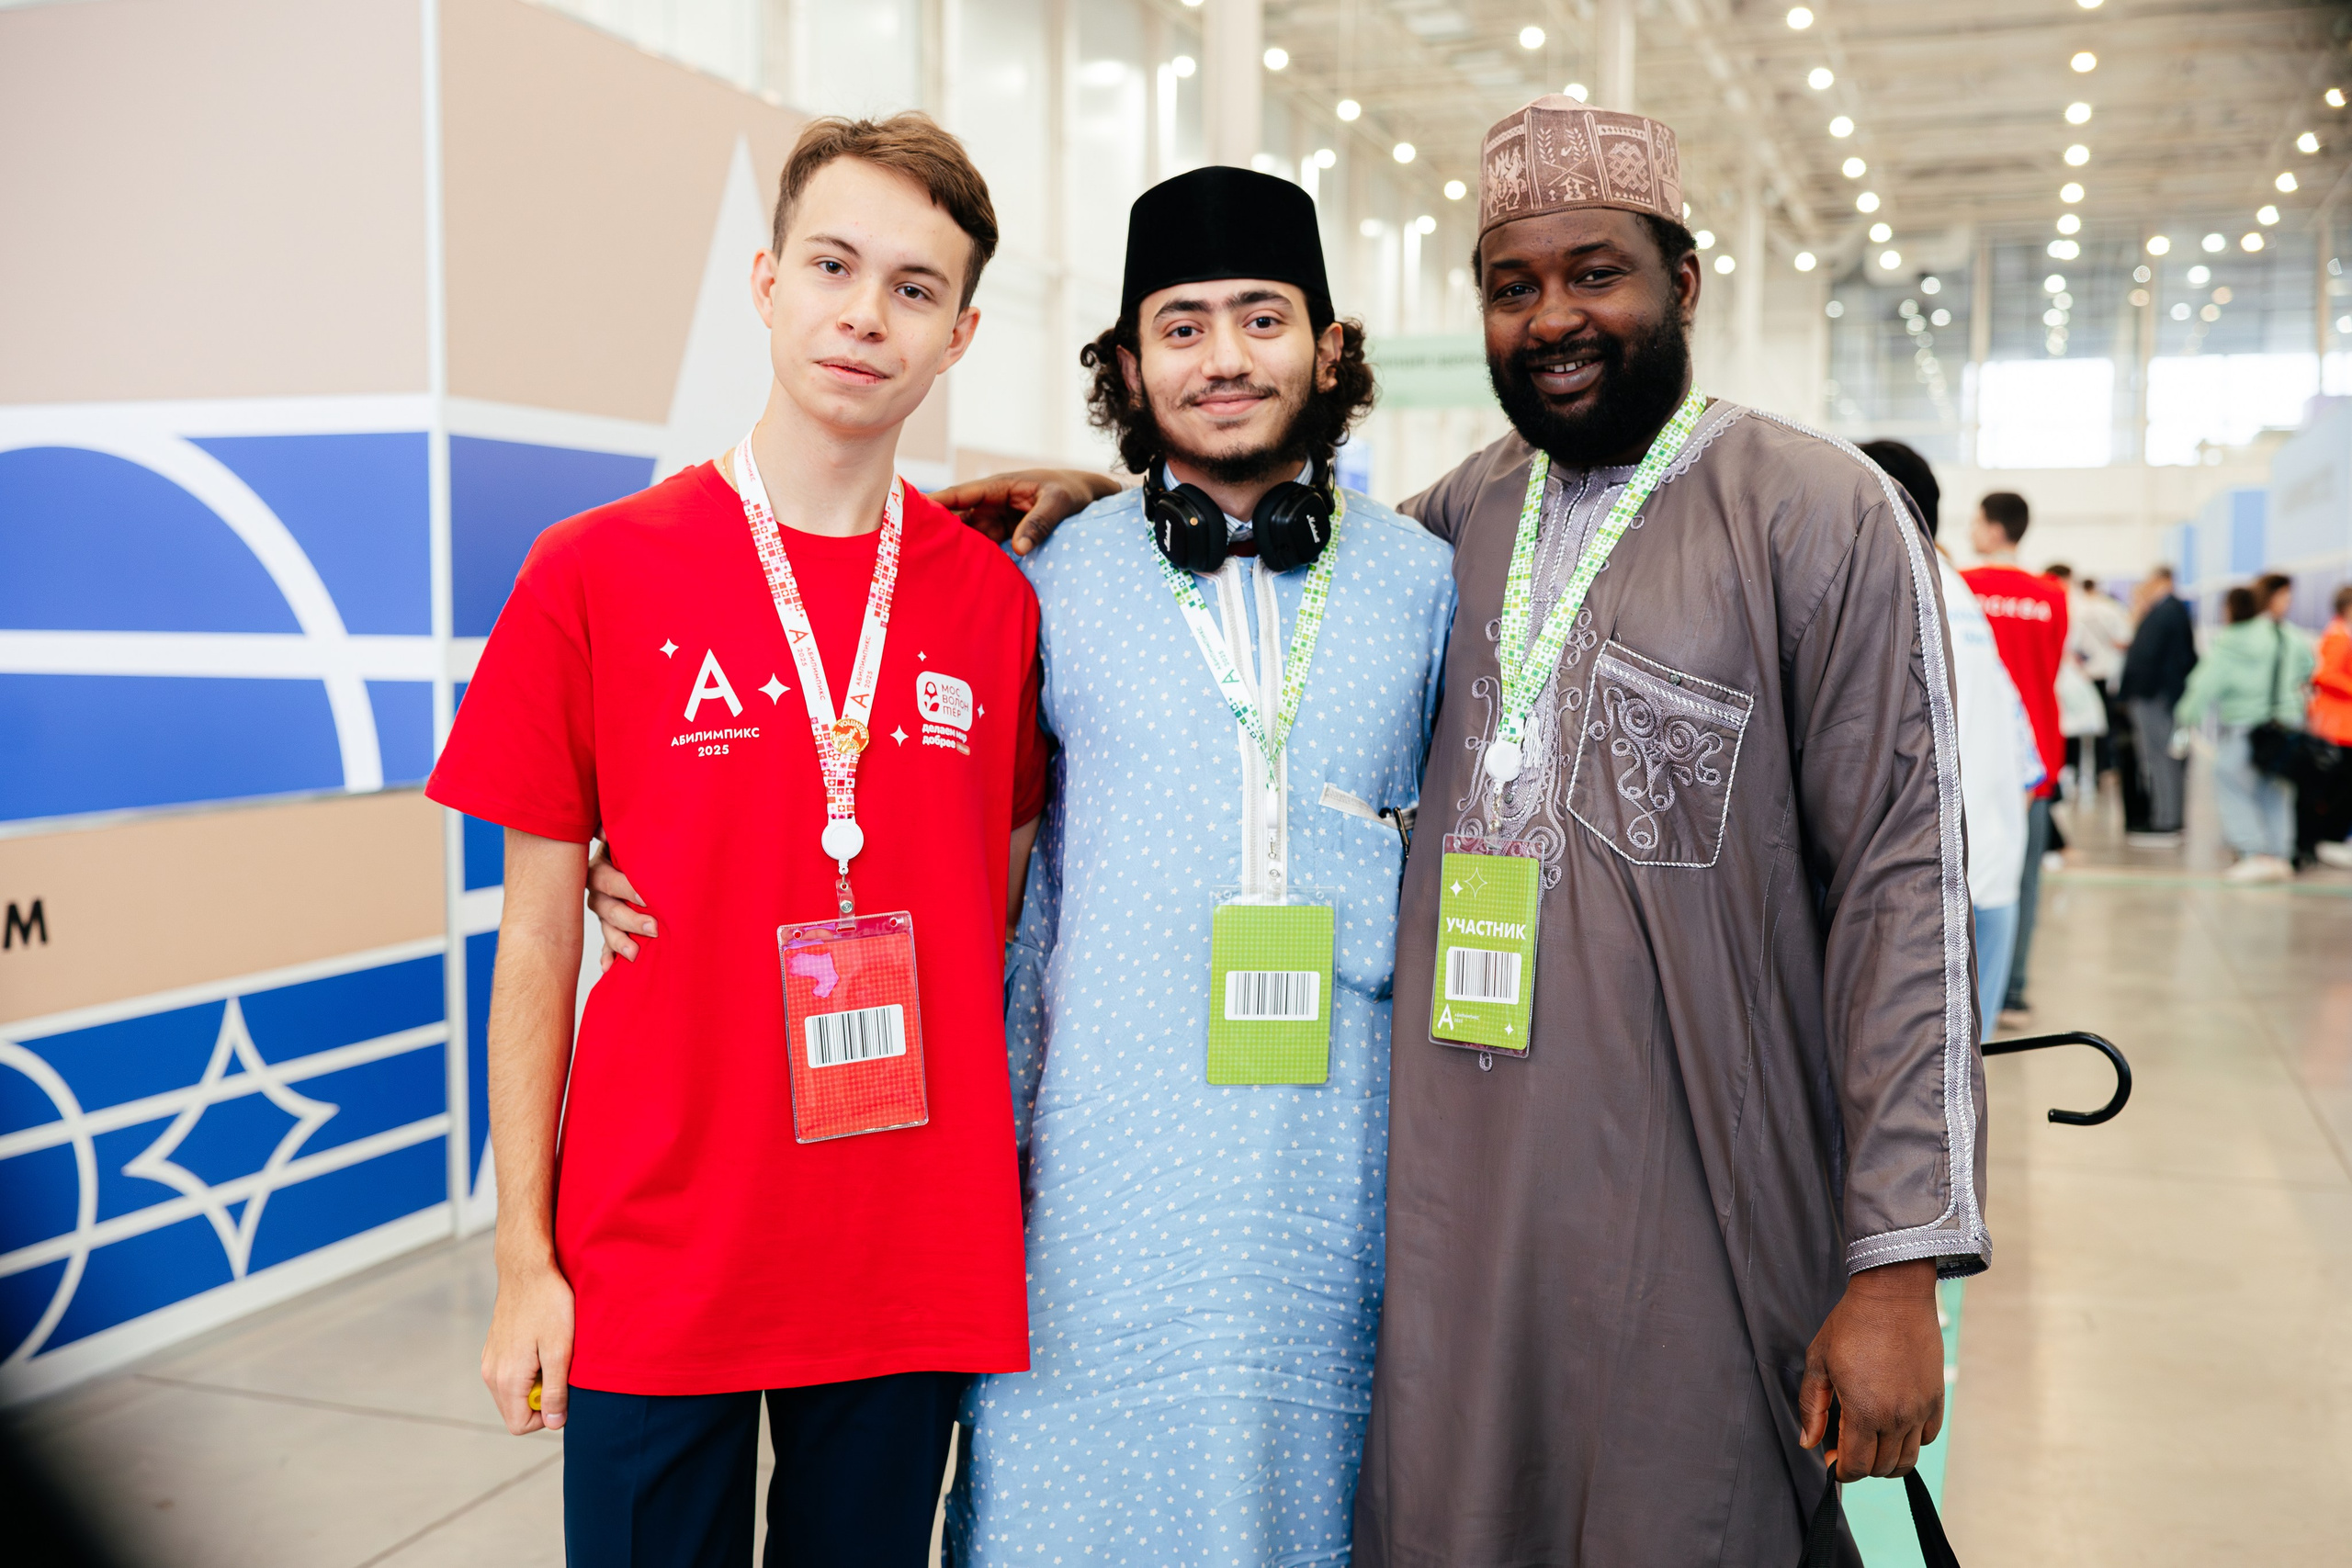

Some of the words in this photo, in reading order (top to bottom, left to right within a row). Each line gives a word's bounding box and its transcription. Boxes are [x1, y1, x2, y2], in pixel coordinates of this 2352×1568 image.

[788, 629, 809, 644] А
[797, 648, 808, 667] 2025
[855, 635, 871, 686] АБИЛИМПИКС
[807, 646, 826, 701] АБИЛИМПИКС
[865, 671, 873, 688] 2025
[1221, 669, 1240, 684] А
[684, 648, 743, 722] А
[941, 683, 961, 697] МОС
[850, 694, 870, 708] А
[942, 694, 969, 712] ВОЛОН
[671, 727, 760, 747] АБИЛИМПИКС
[922, 723, 956, 738] делаем
[697, 744, 729, 757] 2025
[922, 735, 956, 749] добрее
[3, 897, 49, 951] М
[1446, 917, 1527, 940] УЧАСТНИК
[1437, 1002, 1454, 1031] А
